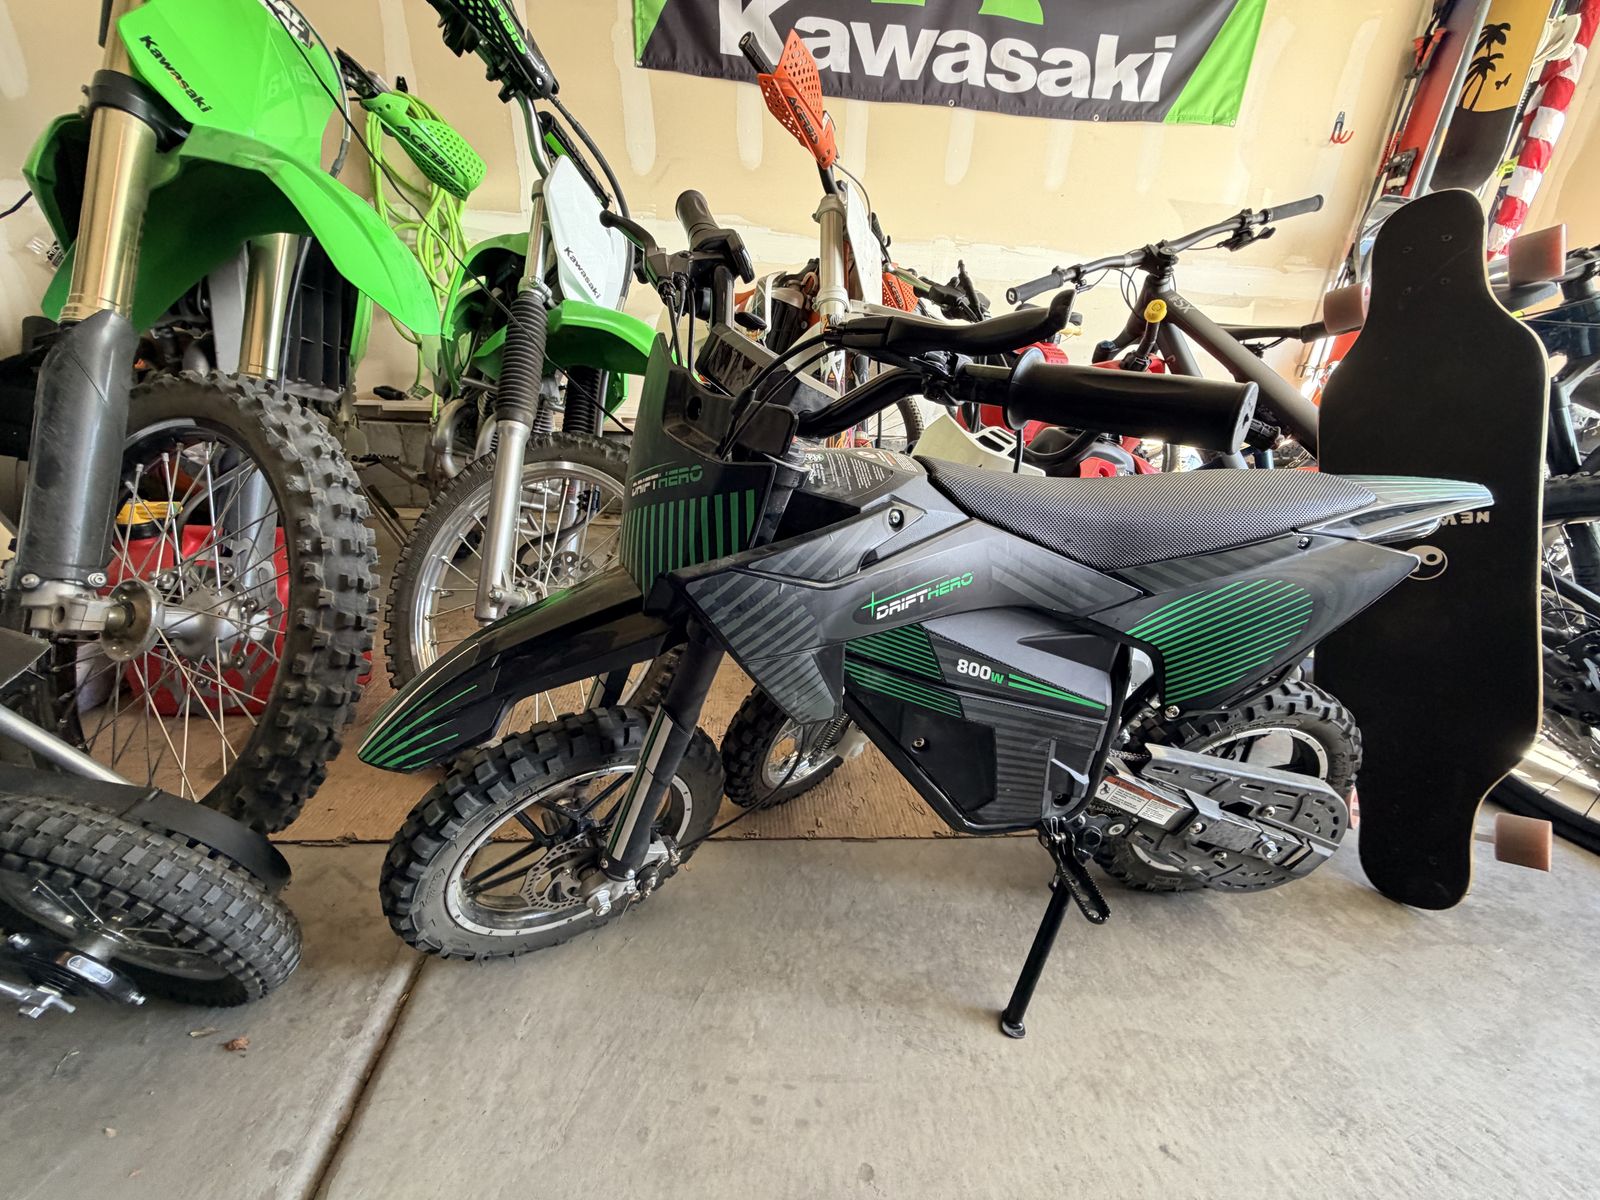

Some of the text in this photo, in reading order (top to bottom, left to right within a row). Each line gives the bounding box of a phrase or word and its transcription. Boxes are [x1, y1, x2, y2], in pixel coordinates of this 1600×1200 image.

[139, 35, 213, 112] Kawasaki
[719, 0, 1177, 102] Kawasaki
[564, 246, 601, 299] Kawasaki
